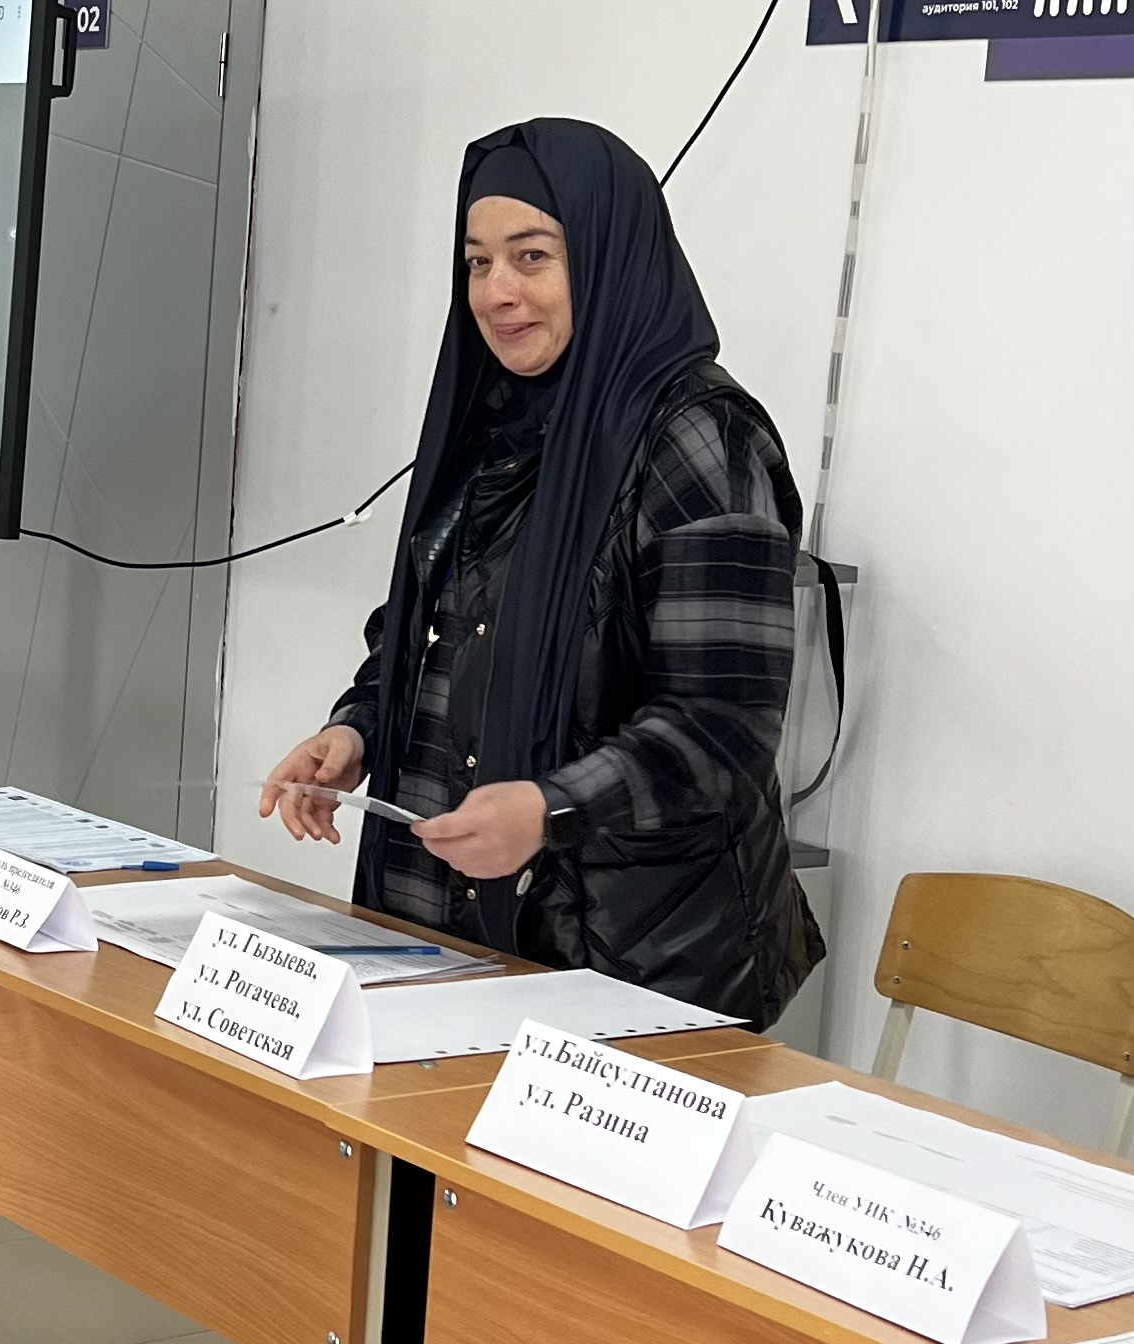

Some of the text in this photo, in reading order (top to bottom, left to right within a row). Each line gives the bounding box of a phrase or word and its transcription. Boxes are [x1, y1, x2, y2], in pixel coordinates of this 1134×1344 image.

[74, 5, 100, 33] 02
[922, 0, 979, 16] аудитория
[982, 0, 999, 12] 101,
[9, 908, 30, 929] Р.З.
[212, 927, 318, 984] ул. Гызыева,
[193, 963, 301, 1023] ул. Рогачева,
[176, 1000, 295, 1061] ул. Советская
[519, 1083, 650, 1144] ул. Разина
[813, 1180, 944, 1242] Член УИК №346
[759, 1197, 954, 1292] Куважукова Н.А.
